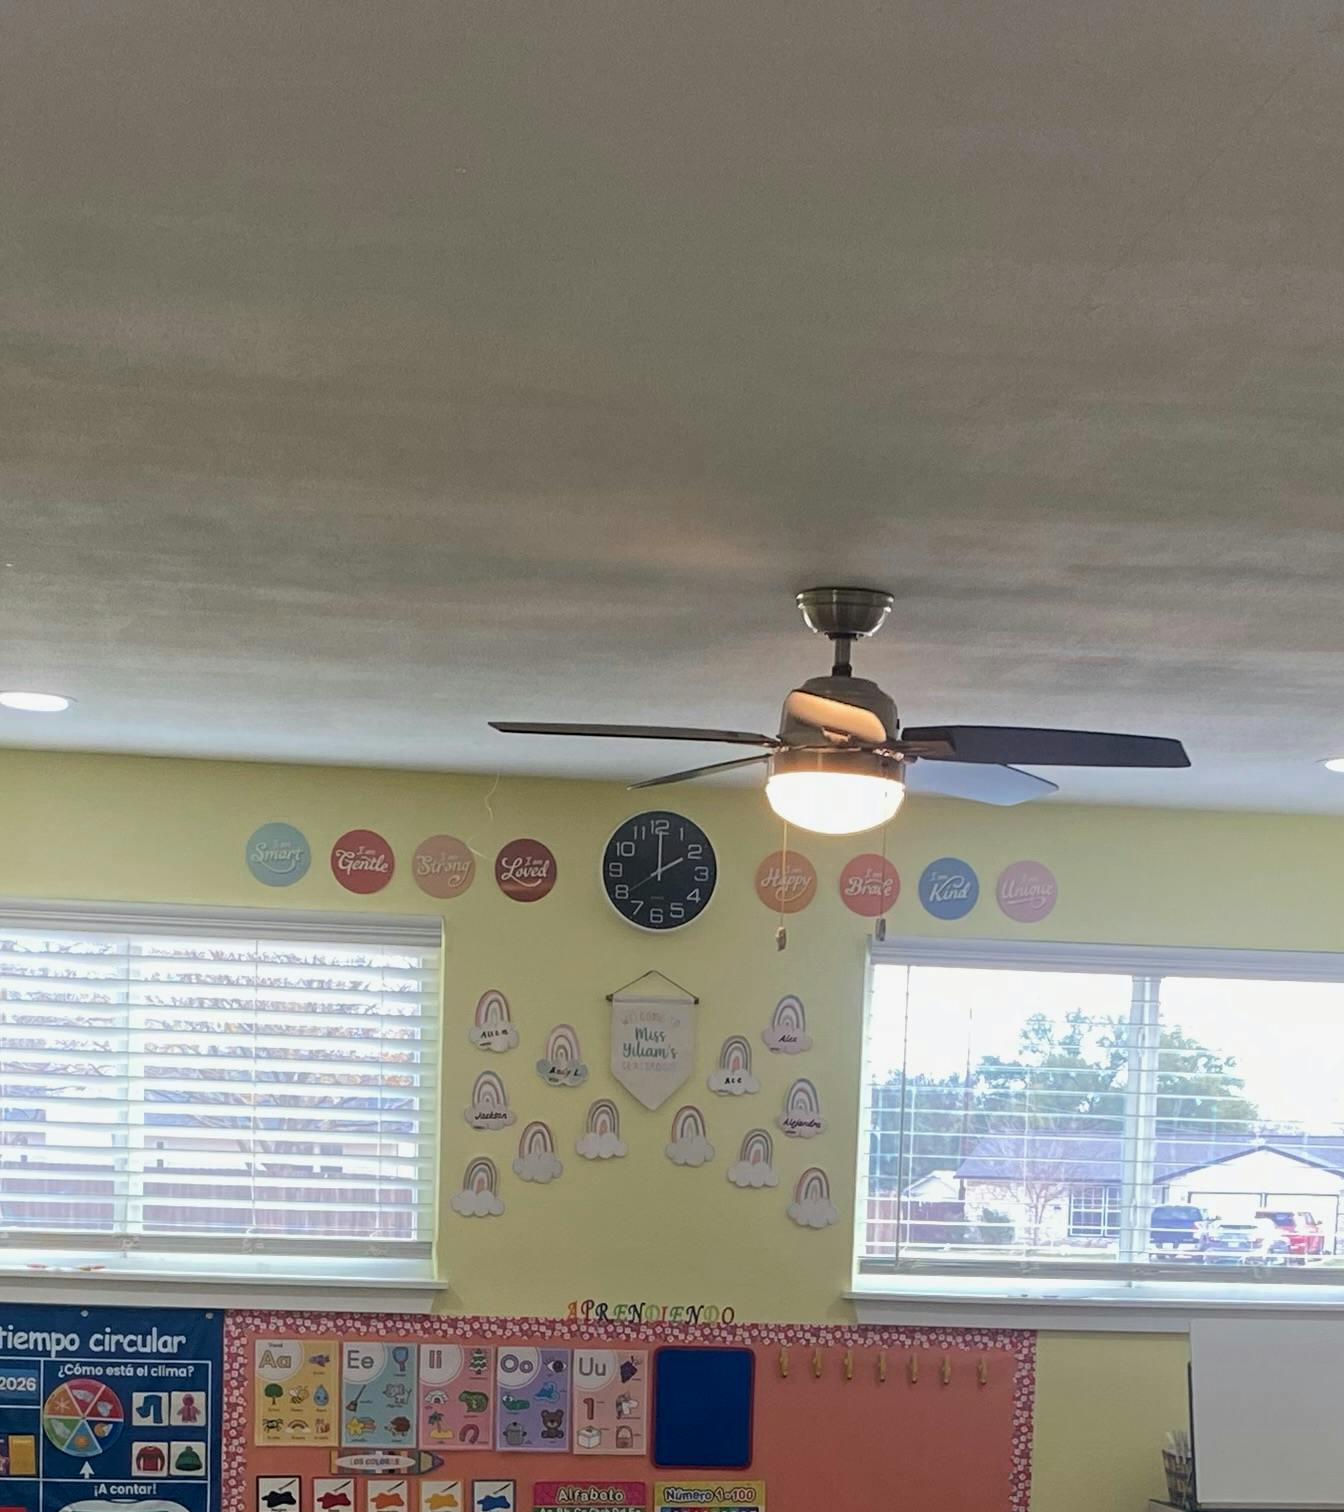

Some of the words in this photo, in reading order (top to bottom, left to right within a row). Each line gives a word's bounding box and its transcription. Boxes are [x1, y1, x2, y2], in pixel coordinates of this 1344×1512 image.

[634, 826, 645, 840] 11
[652, 820, 670, 835] 12
[680, 828, 684, 841] 1
[252, 842, 304, 867] Smart
[617, 842, 635, 857] 10
[688, 844, 703, 860] 2
[336, 850, 389, 875] Gentle
[416, 855, 472, 884] Strong
[502, 857, 550, 882] Loved
[609, 863, 623, 877] 9
[694, 866, 709, 881] 3
[761, 868, 810, 894] Happy
[616, 885, 629, 899] 8
[845, 876, 894, 897] Brave
[930, 876, 968, 901] Kind
[1001, 882, 1054, 903] Unique
[687, 888, 701, 904] 4
[631, 900, 644, 915] 7
[650, 908, 663, 923] 6
[670, 903, 684, 918] 5
[635, 1027, 667, 1042] Miss
[566, 1299, 735, 1325] APRENDIENDO
[89, 1328, 186, 1354] circular
[259, 1350, 292, 1369] Aa
[347, 1350, 374, 1369] Ee
[500, 1354, 533, 1374] Oo
[580, 1357, 606, 1377] Uu
[58, 1364, 103, 1378] ¿Cómo
[106, 1363, 134, 1377] está
[136, 1365, 149, 1377] el
[151, 1365, 195, 1377] clima?
[110, 1484, 157, 1495] contar!
[558, 1487, 625, 1503] Alfabeto
[666, 1488, 713, 1503] Número
